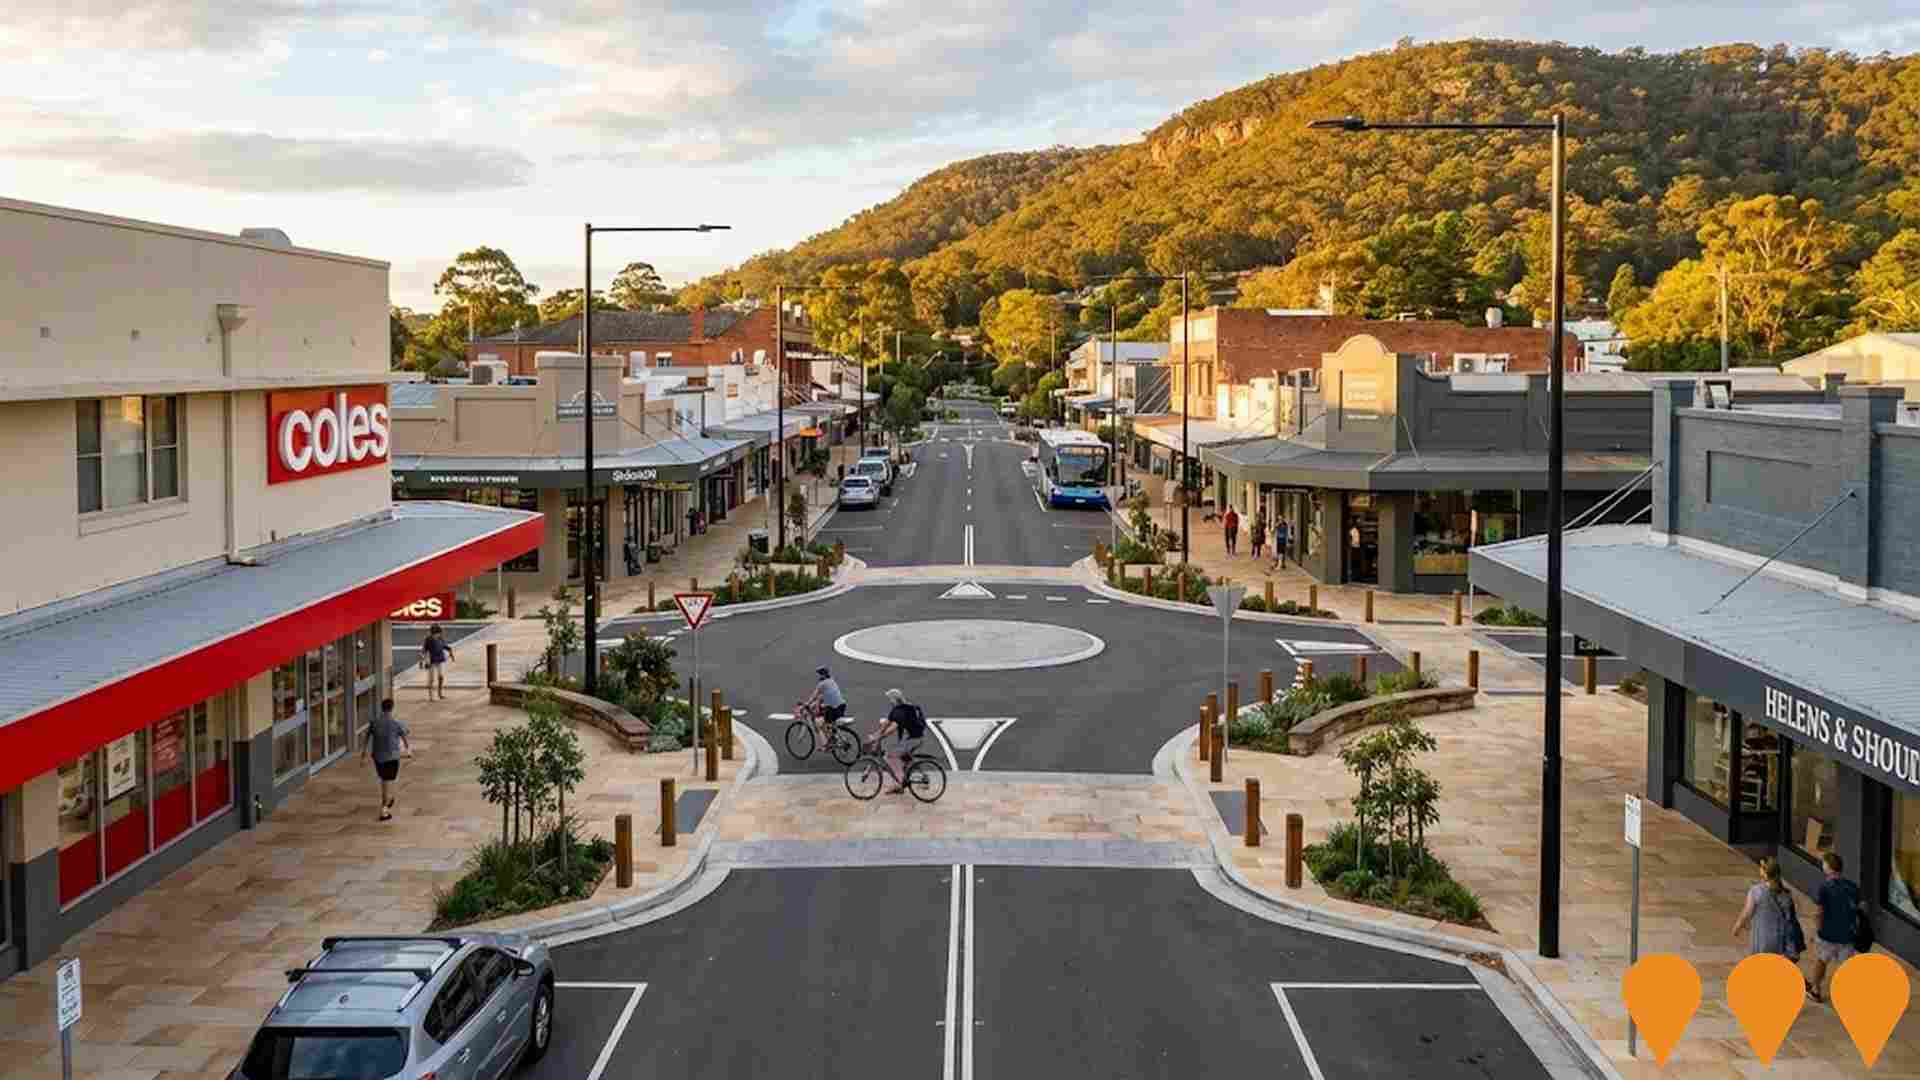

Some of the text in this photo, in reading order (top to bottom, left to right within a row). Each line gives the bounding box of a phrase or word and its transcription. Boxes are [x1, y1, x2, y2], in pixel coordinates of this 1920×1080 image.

[282, 392, 389, 472] coles
[1765, 686, 1831, 744] HELENS
[1834, 716, 1848, 752] &
